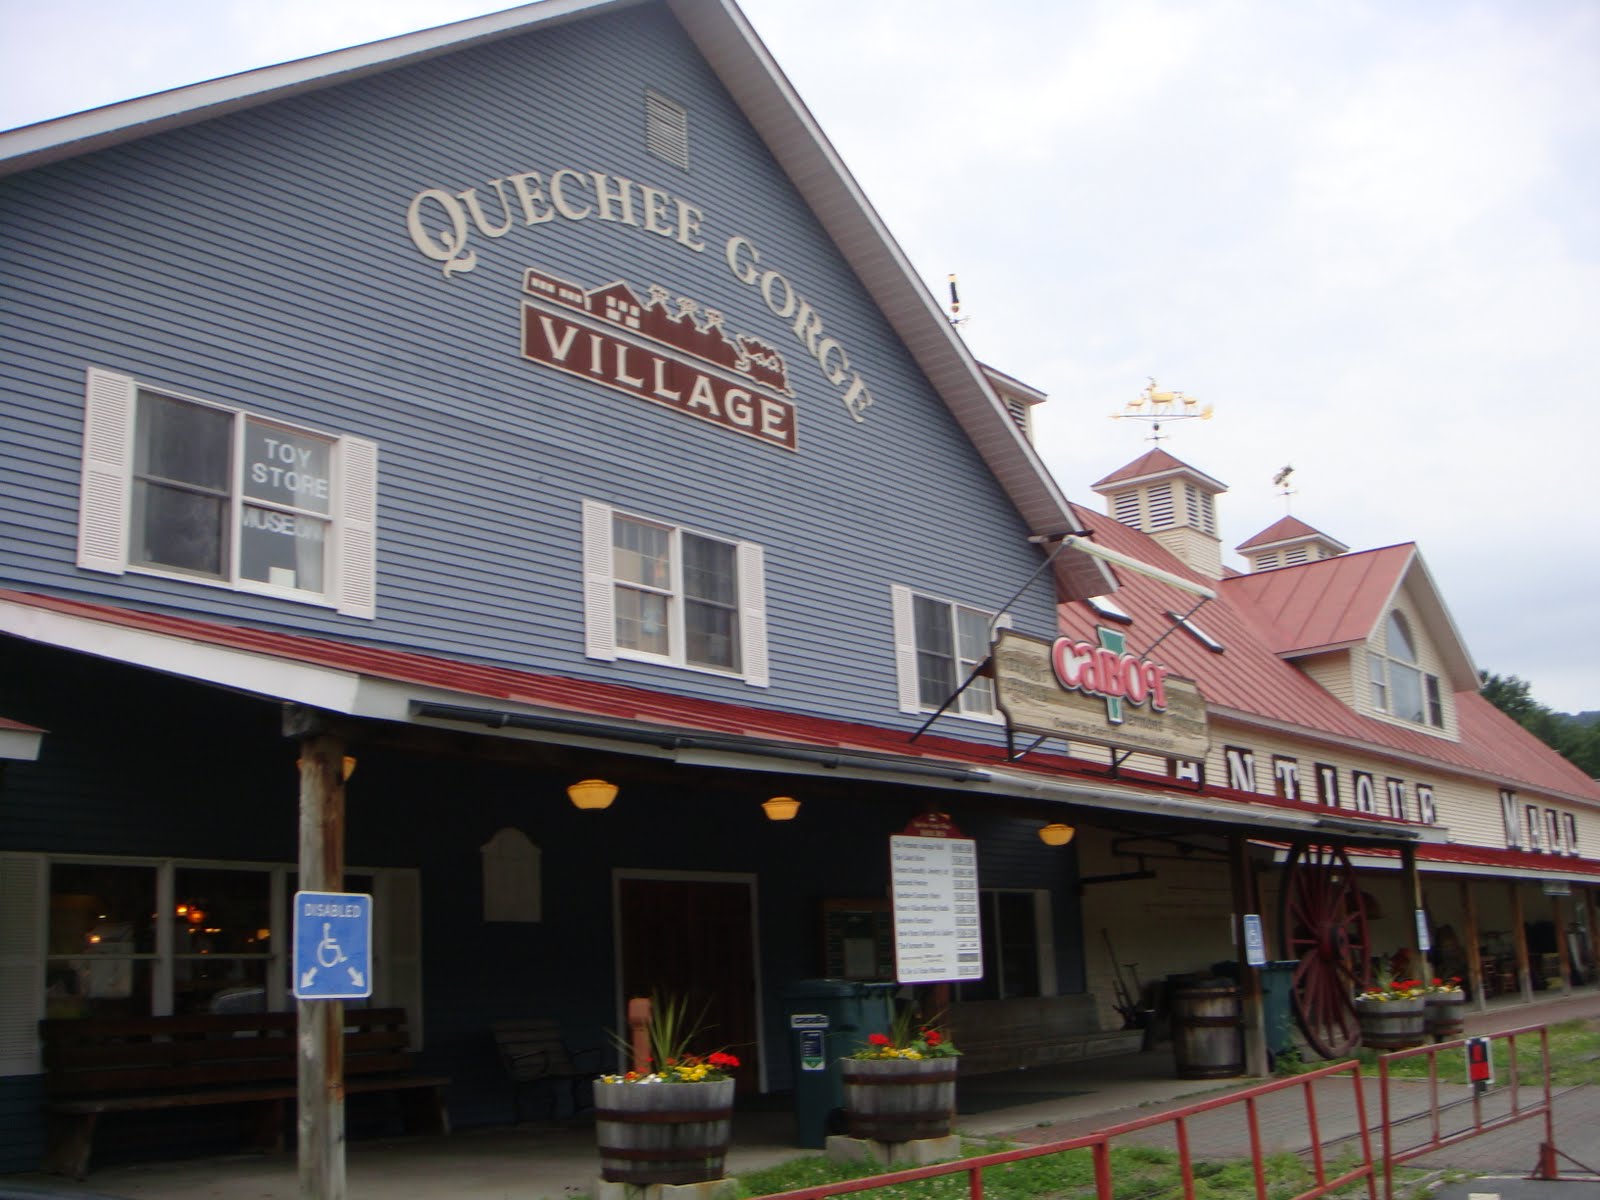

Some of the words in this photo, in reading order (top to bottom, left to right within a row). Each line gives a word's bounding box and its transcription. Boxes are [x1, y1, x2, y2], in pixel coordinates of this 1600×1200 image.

[406, 168, 706, 279] QUECHEE
[725, 235, 874, 423] GORGE
[538, 315, 788, 441] VILLAGE
[264, 437, 313, 469] TOY
[251, 462, 329, 499] STORE
[304, 903, 361, 918] DISABLED
